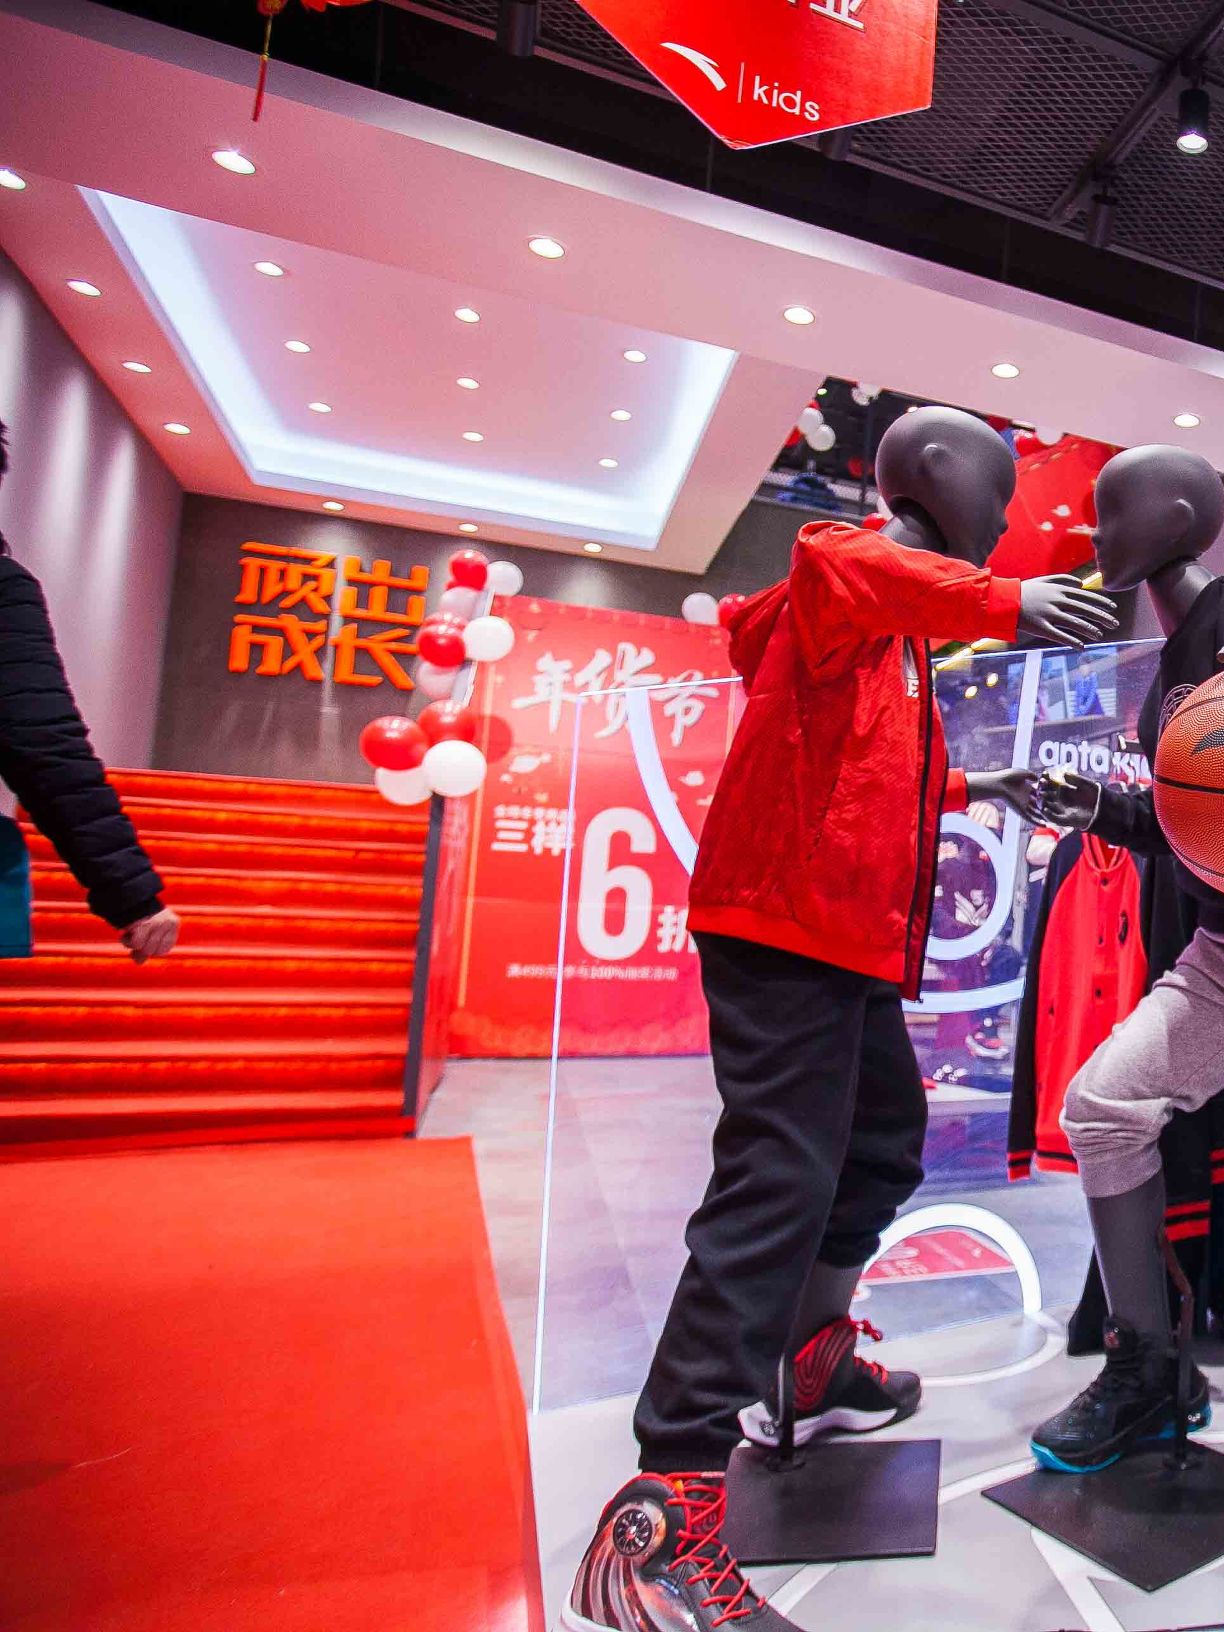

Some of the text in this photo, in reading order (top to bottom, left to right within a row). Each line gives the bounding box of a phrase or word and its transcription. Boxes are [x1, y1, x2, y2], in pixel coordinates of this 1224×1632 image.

[752, 75, 821, 121] kids
[228, 613, 418, 690] 成长
[577, 807, 657, 961] 6
